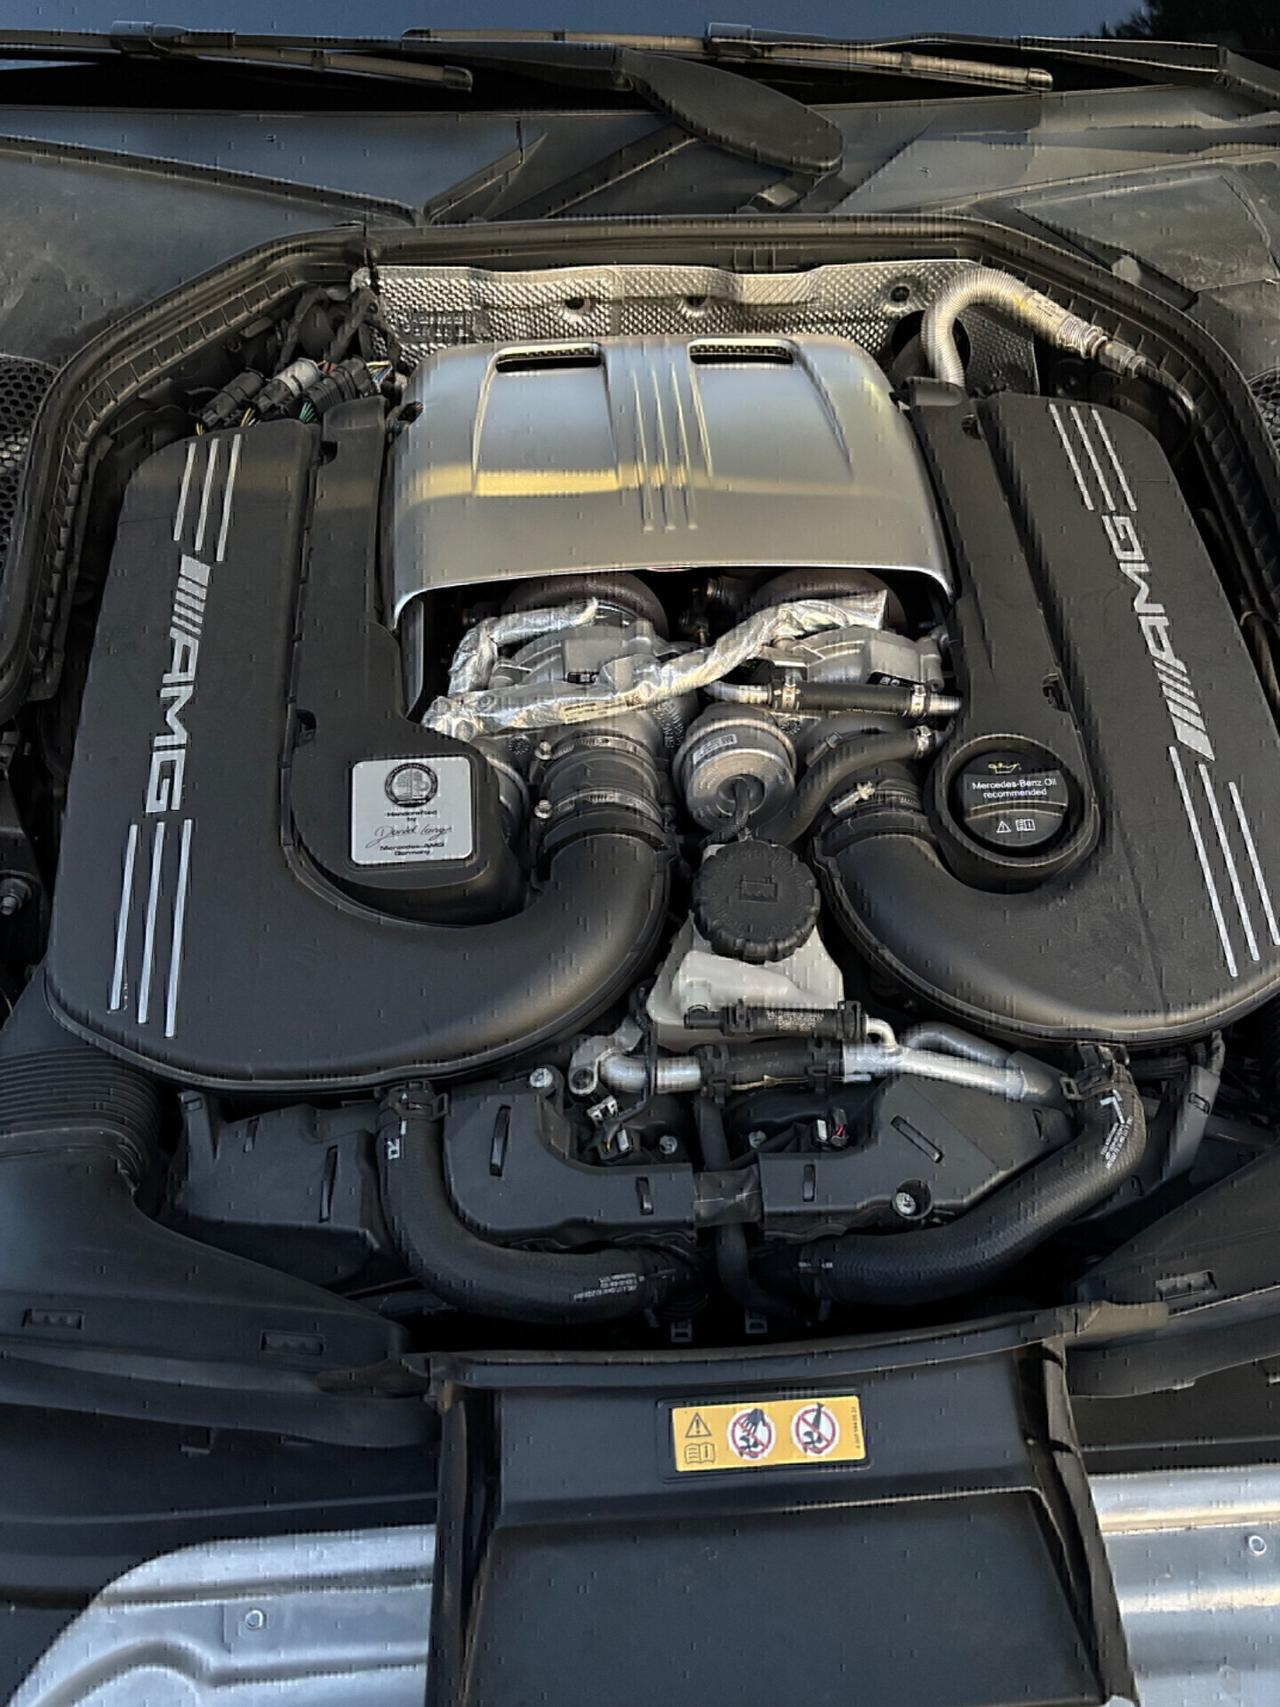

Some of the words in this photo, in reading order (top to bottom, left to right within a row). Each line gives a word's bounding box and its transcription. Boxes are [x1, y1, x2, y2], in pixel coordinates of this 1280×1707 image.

[145, 626, 200, 813] AMG
[972, 779, 1042, 790] Mercedes-Benz
[1044, 778, 1057, 786] Oil
[983, 789, 1048, 799] recommended
